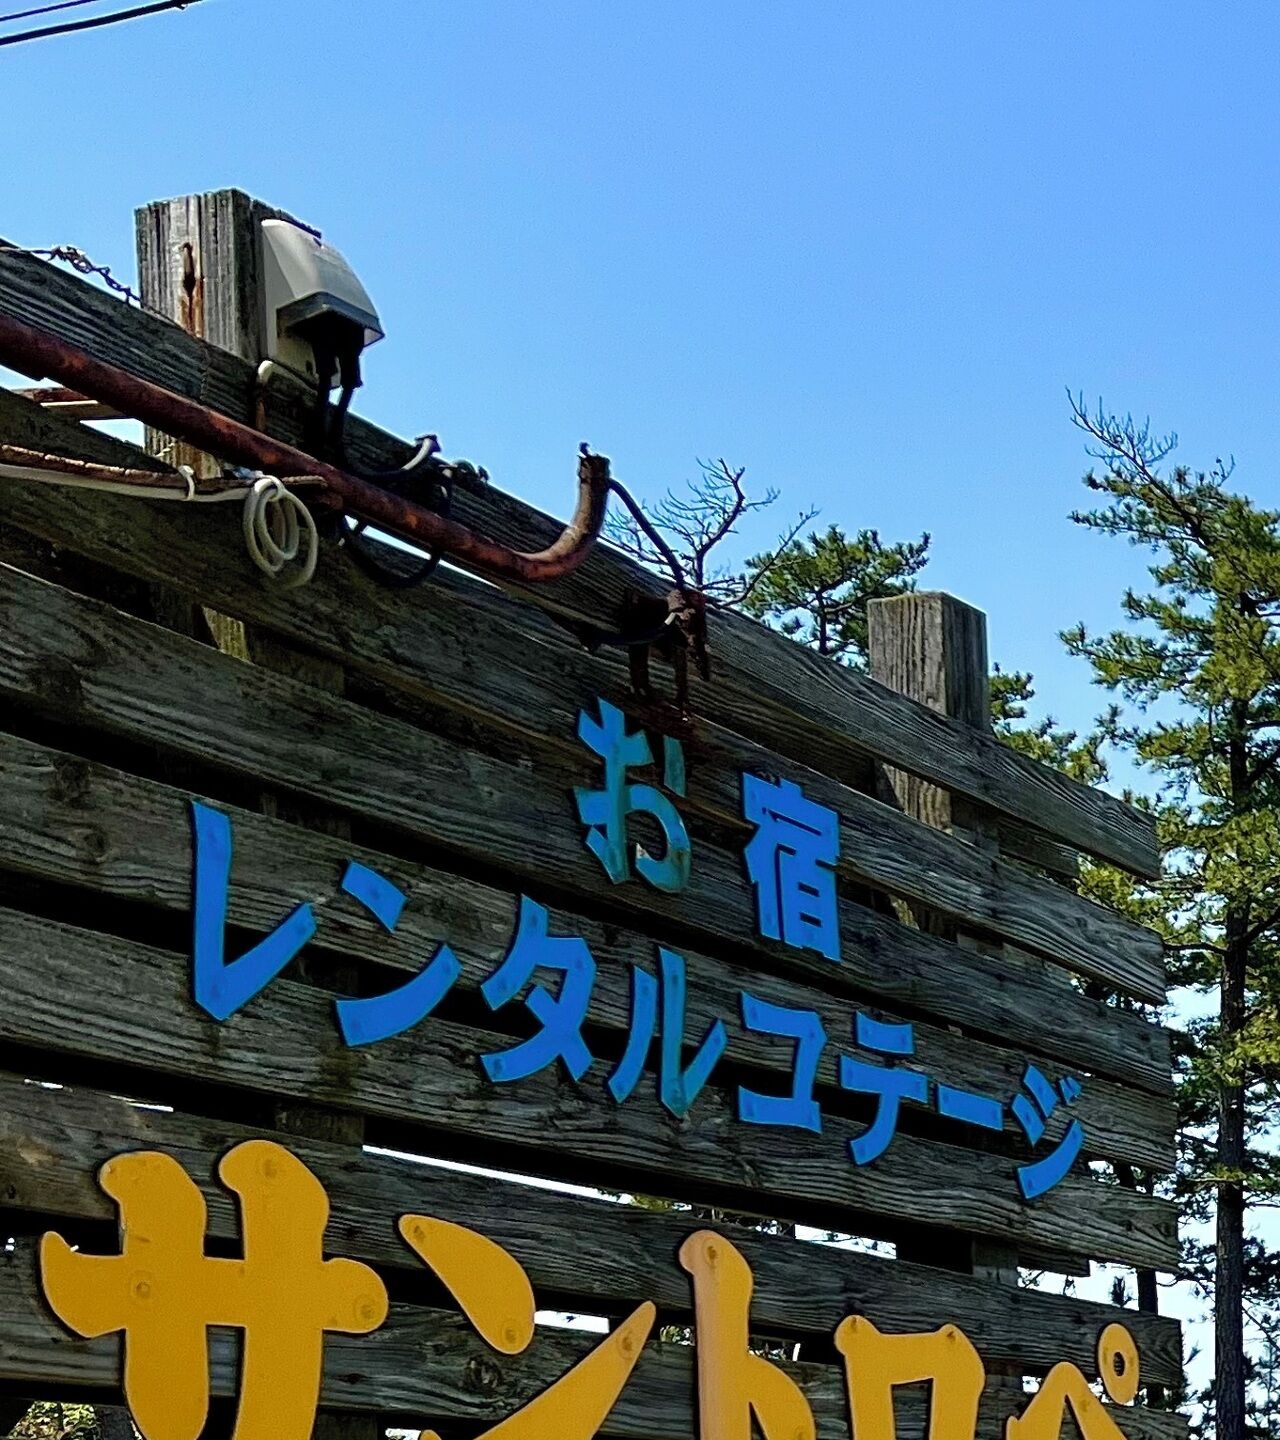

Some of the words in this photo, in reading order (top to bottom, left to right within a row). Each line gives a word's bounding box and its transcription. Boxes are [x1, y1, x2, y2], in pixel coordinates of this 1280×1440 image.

[573, 697, 841, 962] お宿
[191, 801, 1084, 1199] レンタルコテージ
